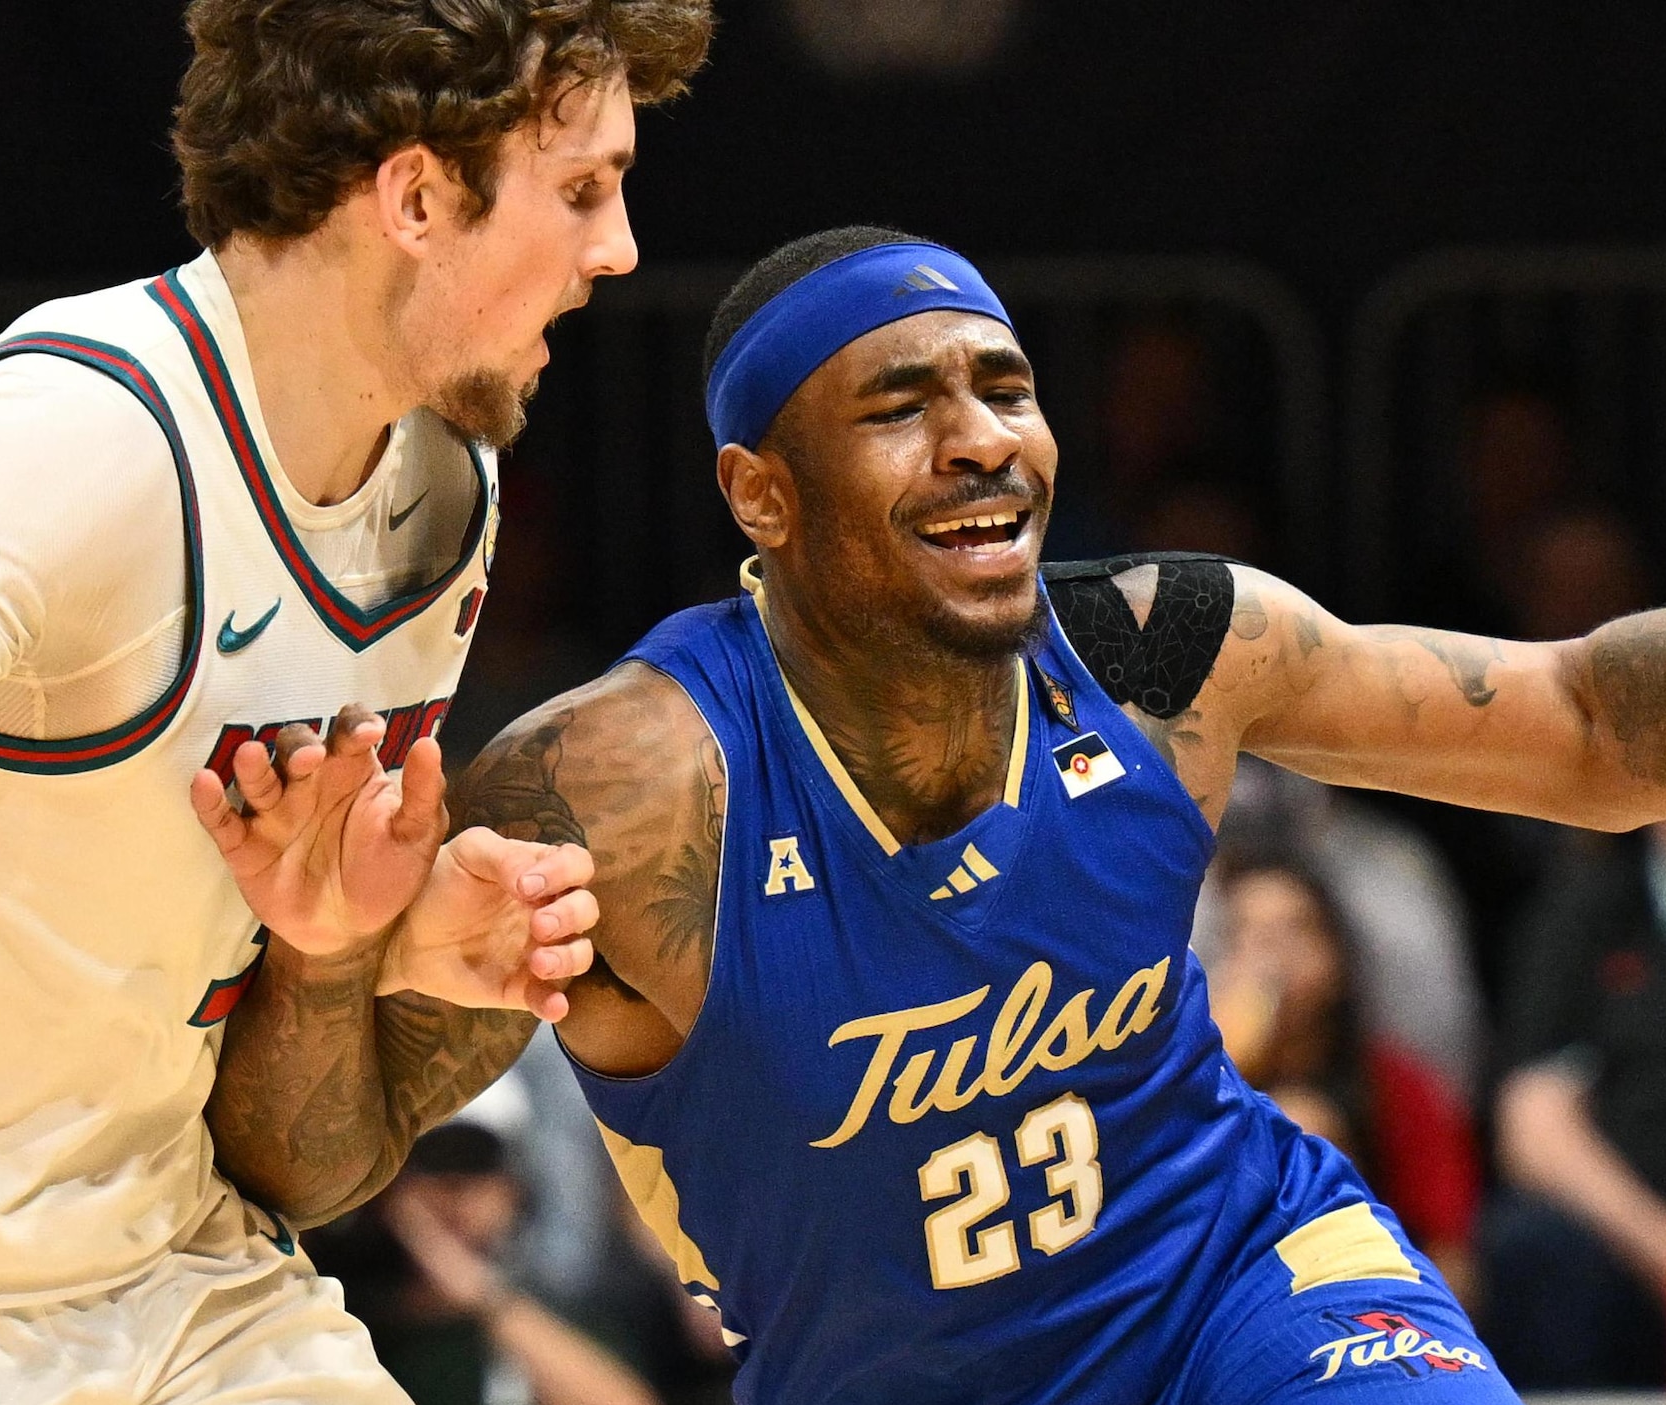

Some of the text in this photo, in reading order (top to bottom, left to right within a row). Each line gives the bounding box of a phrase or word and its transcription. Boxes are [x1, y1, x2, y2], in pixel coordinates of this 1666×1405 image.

[808, 955, 1171, 1149] Tulsa
[917, 1091, 1104, 1291] 23
[1309, 1328, 1487, 1383] Tulsa
